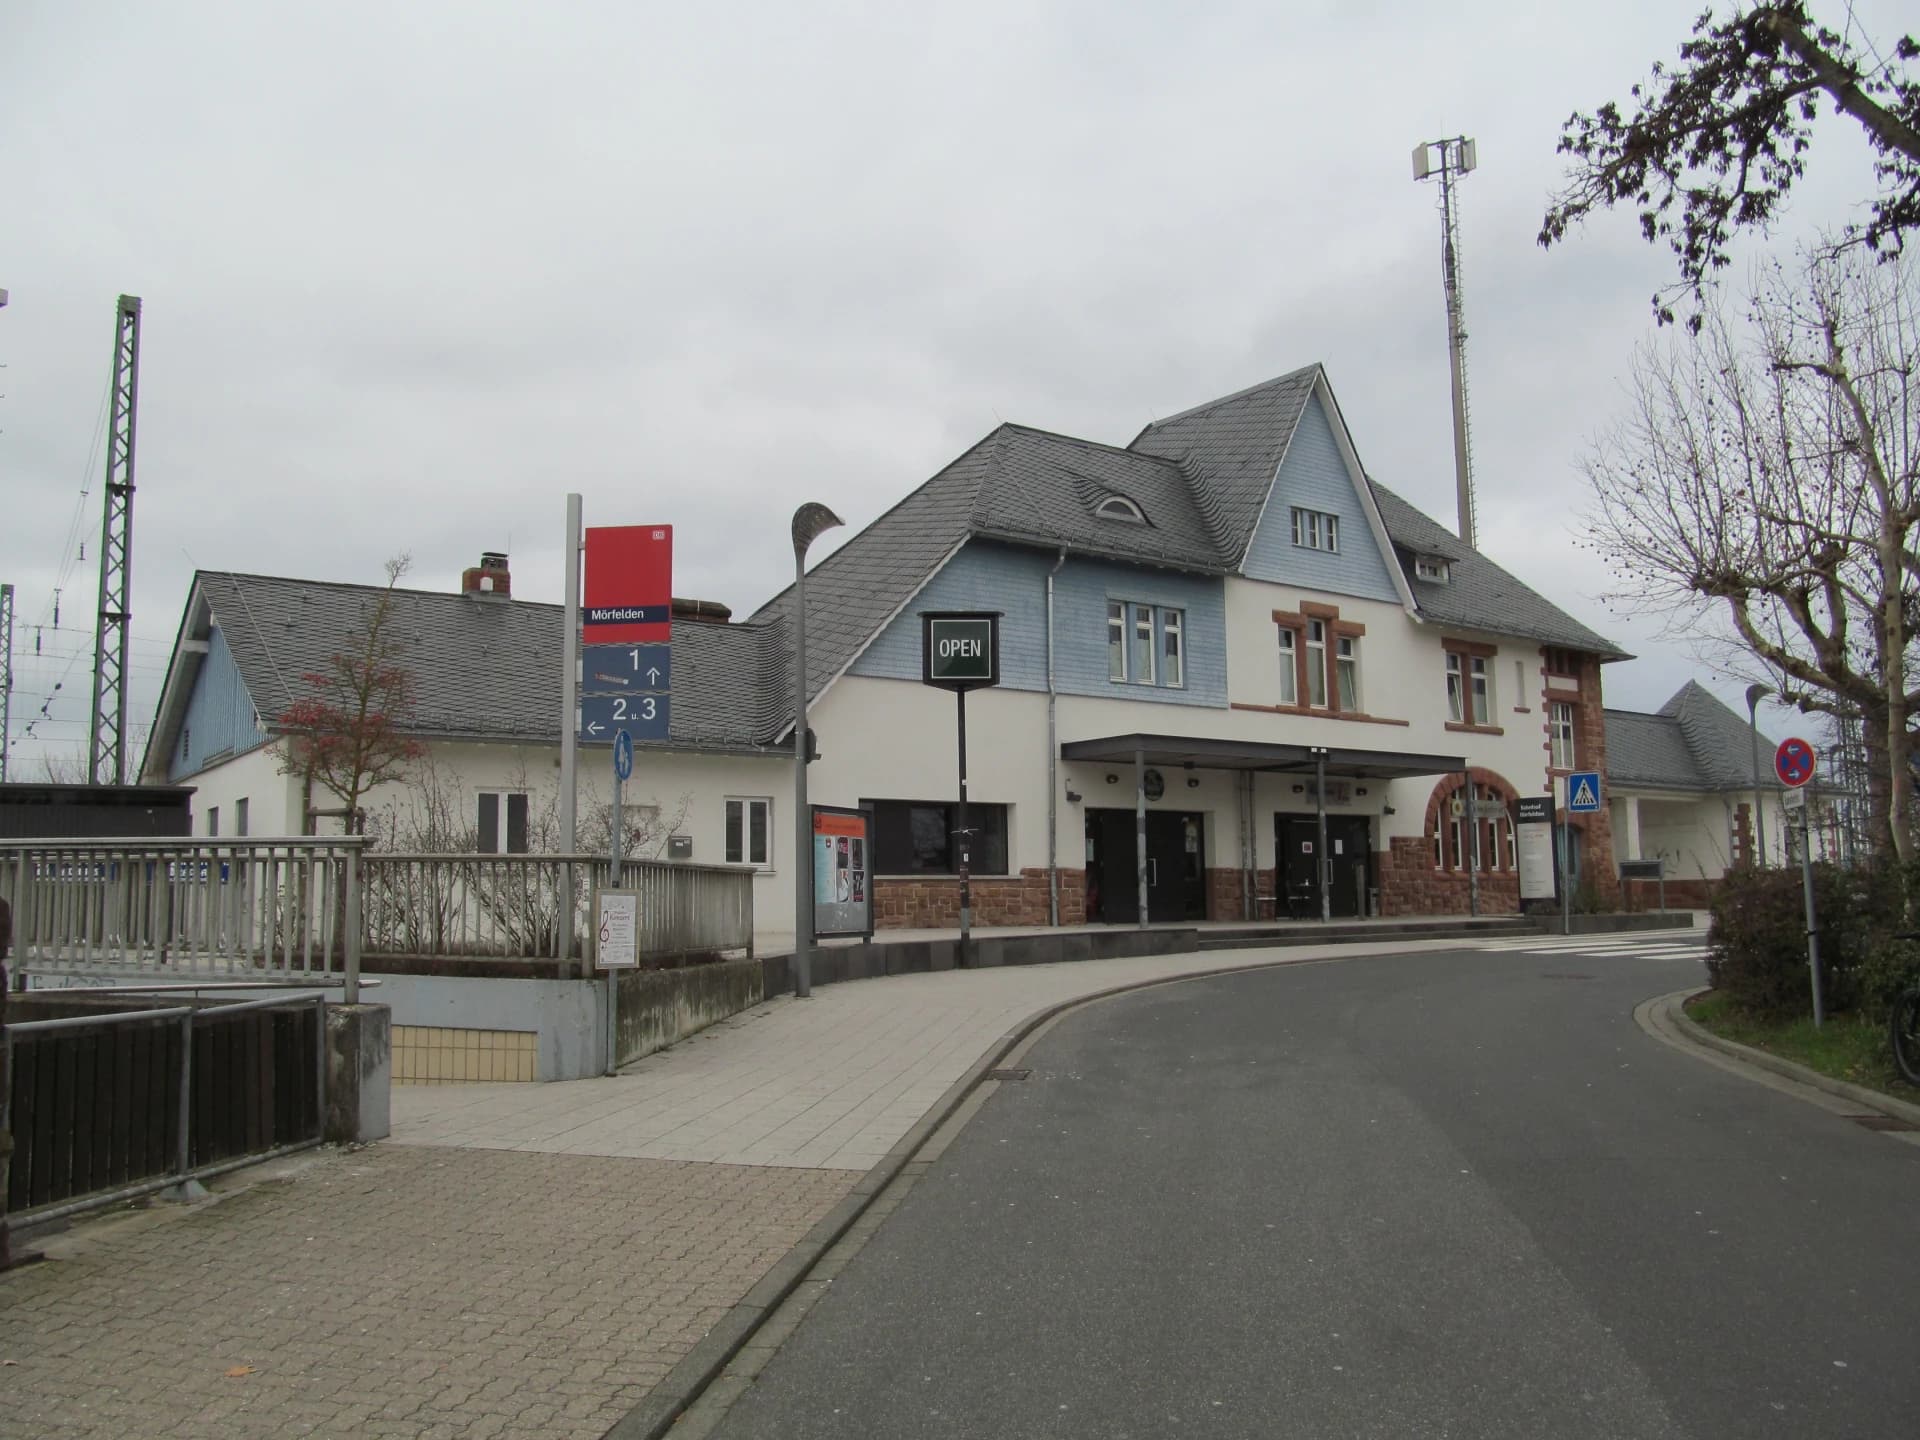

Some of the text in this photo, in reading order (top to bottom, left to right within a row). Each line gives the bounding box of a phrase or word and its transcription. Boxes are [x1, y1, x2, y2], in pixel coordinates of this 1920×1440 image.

[591, 609, 644, 620] Mörfelden
[939, 639, 981, 657] OPEN
[629, 649, 639, 671] 1
[612, 697, 656, 720] 2 u. 3
